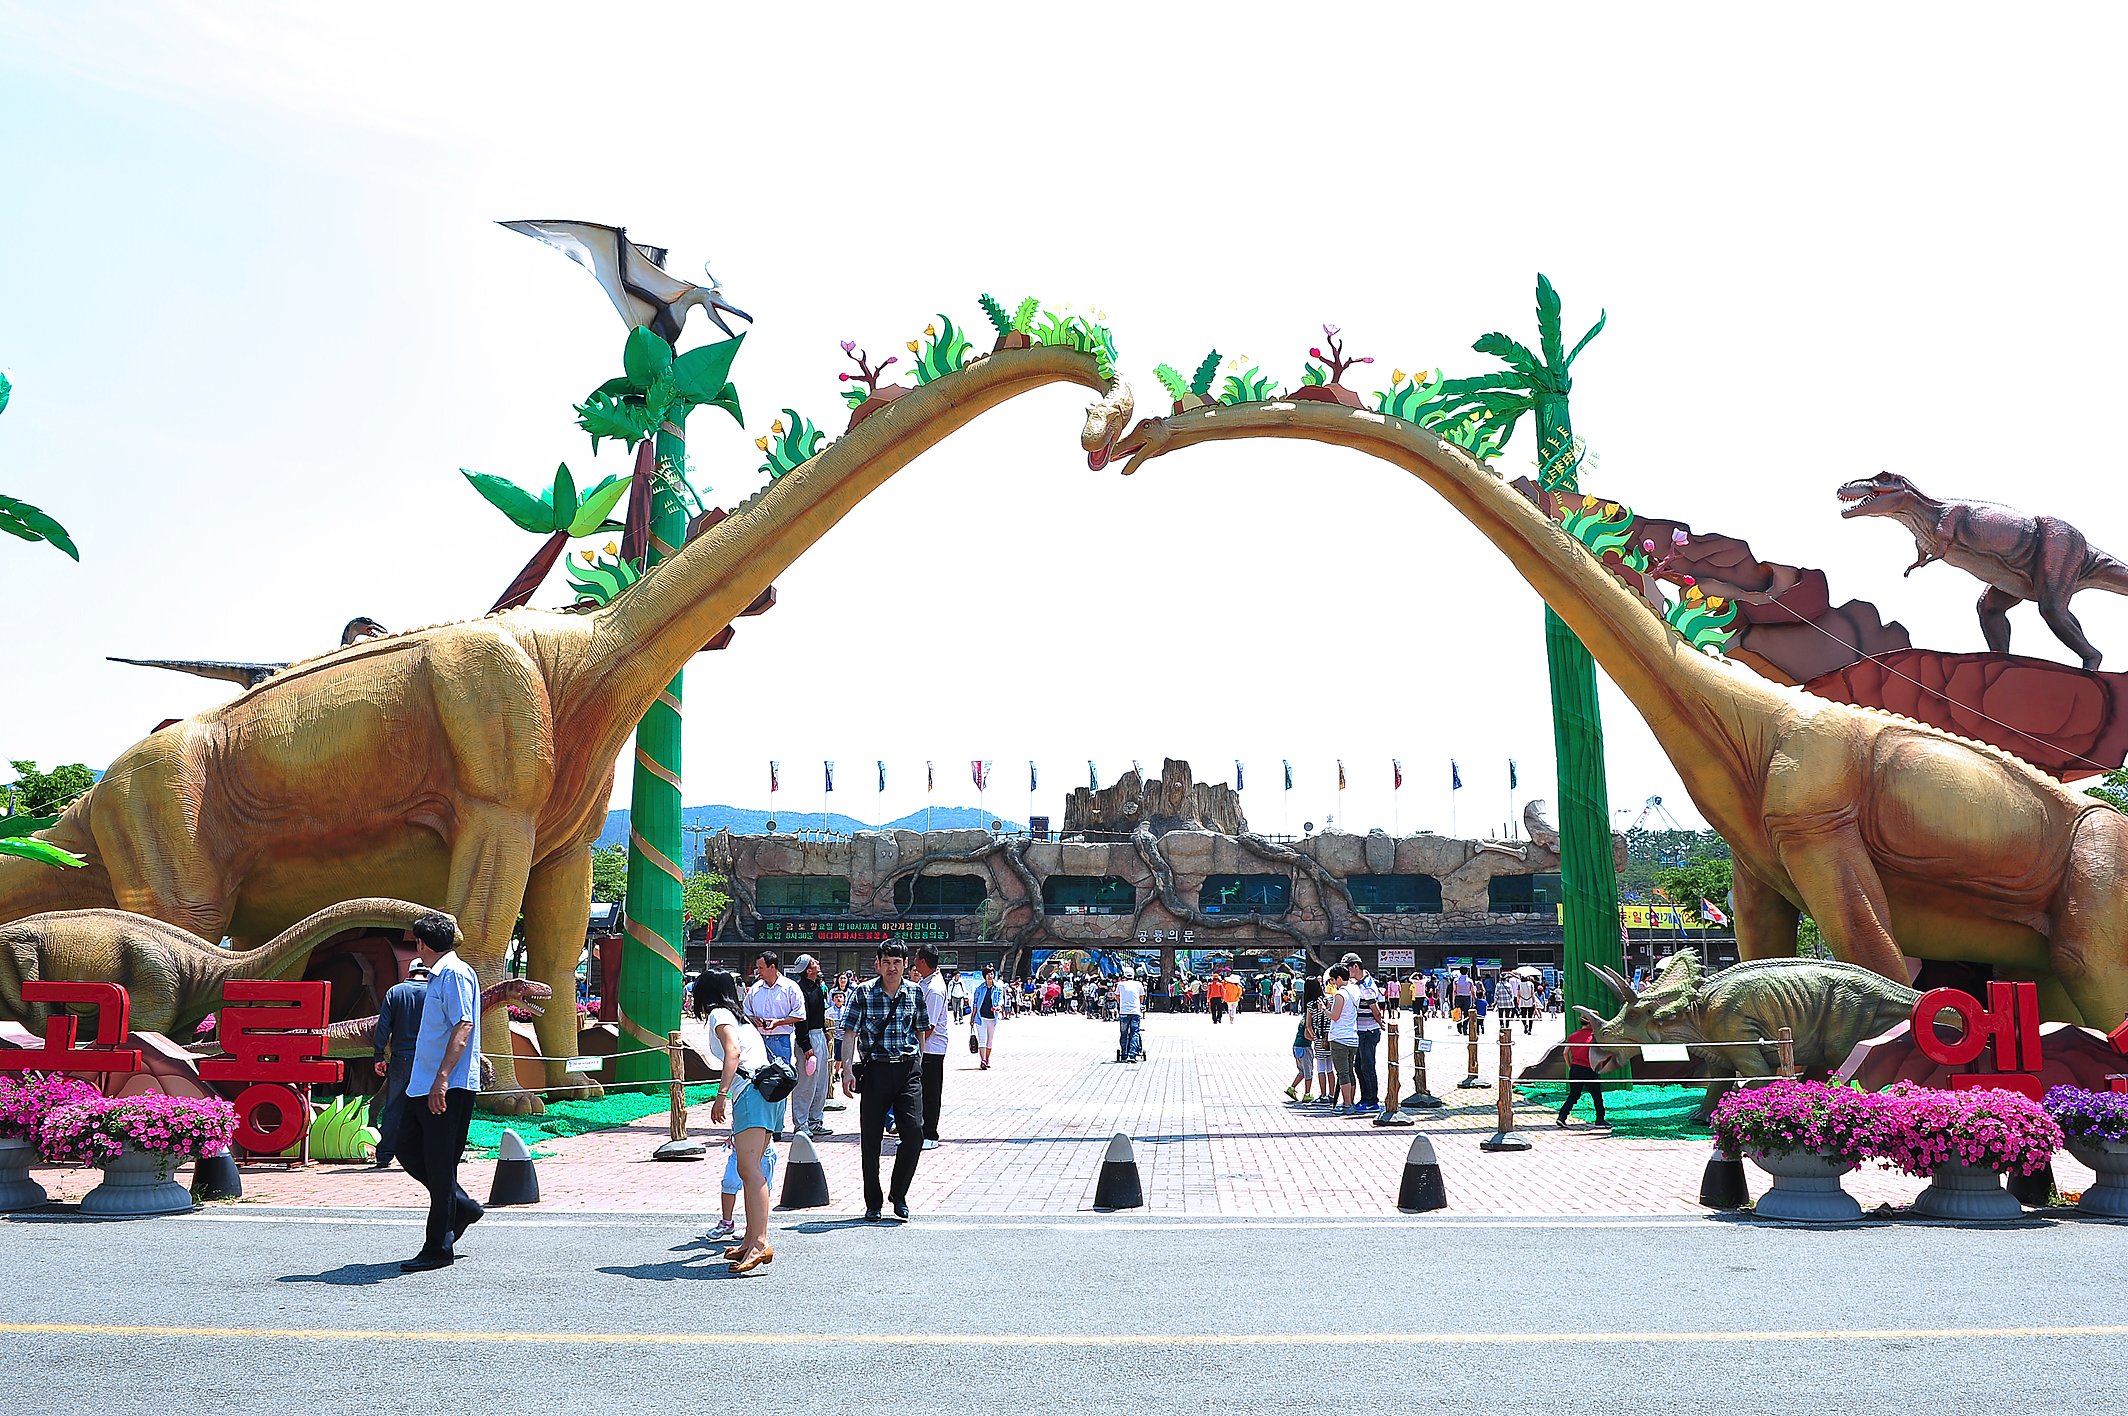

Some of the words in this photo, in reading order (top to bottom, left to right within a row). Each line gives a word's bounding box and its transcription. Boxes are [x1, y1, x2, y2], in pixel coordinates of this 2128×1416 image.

[766, 922, 782, 931] 매주
[786, 922, 794, 931] 금
[758, 931, 782, 940] 오늘밤
[1137, 929, 1195, 943] 공룡의문
